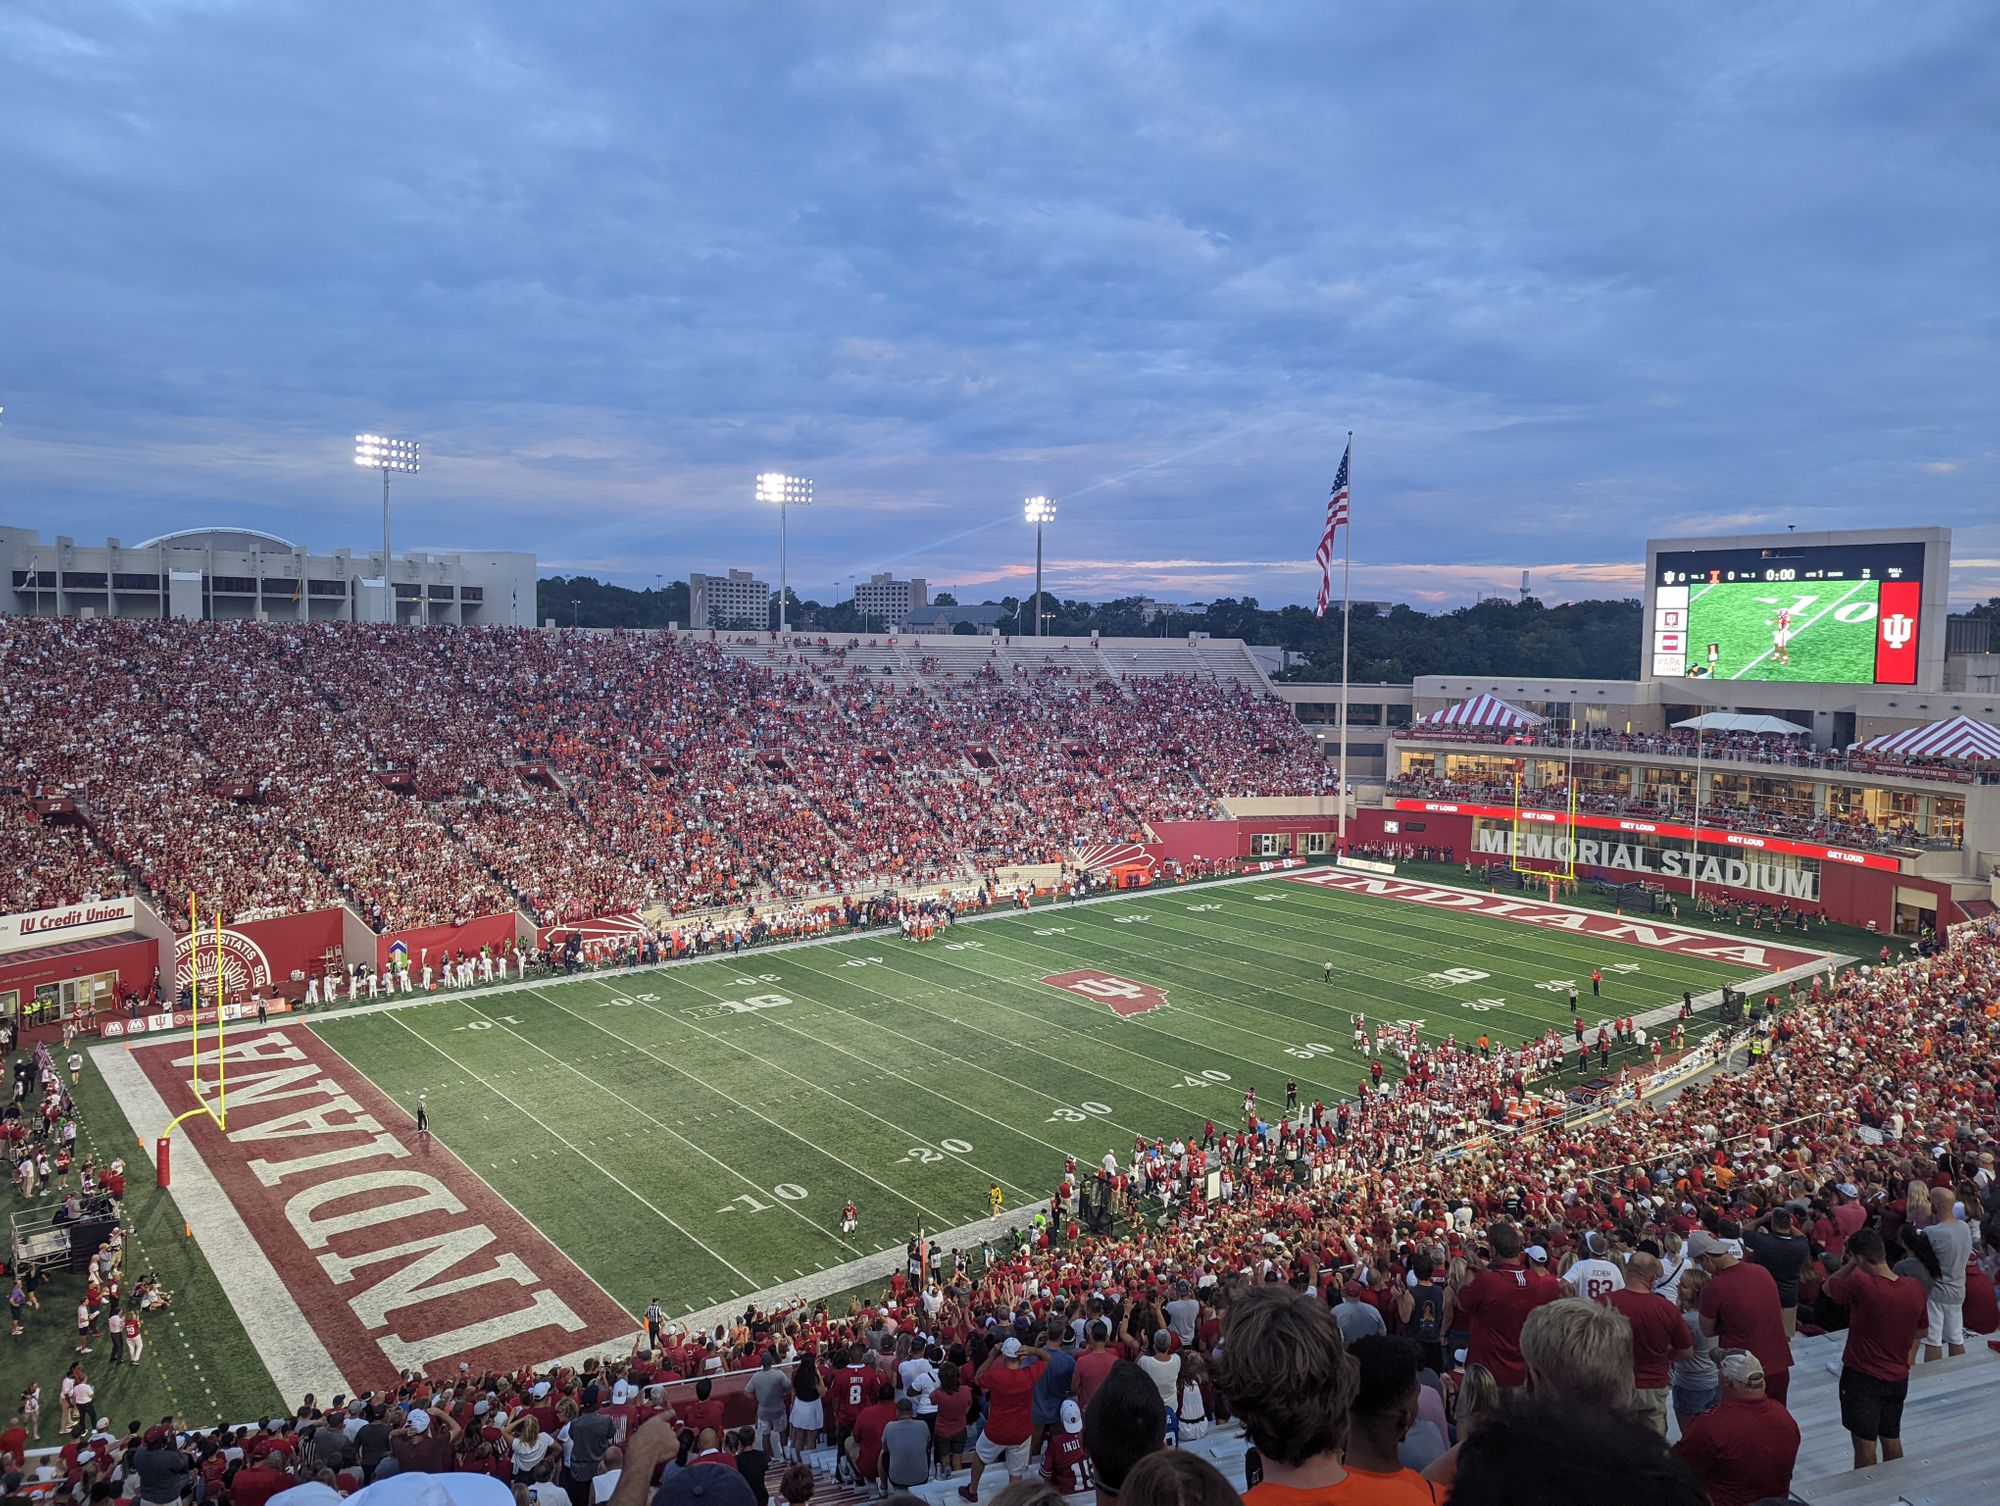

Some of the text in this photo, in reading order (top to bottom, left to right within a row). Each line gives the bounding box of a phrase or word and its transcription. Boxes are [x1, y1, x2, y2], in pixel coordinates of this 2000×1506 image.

[1679, 573, 1685, 581] 0
[1728, 571, 1734, 580] 0
[1766, 569, 1796, 580] 0:00
[1658, 657, 1680, 665] PAPA
[1426, 803, 1458, 812] GET LOUD
[1536, 813, 1555, 821] LOUD
[1620, 821, 1655, 831] GET LOUD
[1728, 835, 1764, 847] GET LOUD
[1479, 828, 1813, 900] MEMORIAL STADIUM
[1827, 851, 1864, 864] GET LOUD
[20, 905, 125, 932] IU Credit Union
[1294, 872, 1773, 967] INDIANA
[846, 956, 883, 967] 40
[735, 974, 782, 986] 30
[611, 993, 661, 1007] 20
[1461, 998, 1505, 1011] 30
[468, 1015, 525, 1030] 10
[1284, 1043, 1335, 1059] 50
[1184, 1069, 1232, 1088] 40
[1052, 1101, 1113, 1122] 30
[908, 1138, 974, 1164] 20
[172, 1032, 587, 1378] INDIANA
[732, 1183, 808, 1213] 10
[1592, 1269, 1611, 1277] JOCHEM
[1587, 1279, 1614, 1299] 83
[849, 1385, 862, 1405] 8
[1062, 1439, 1081, 1453] INDI
